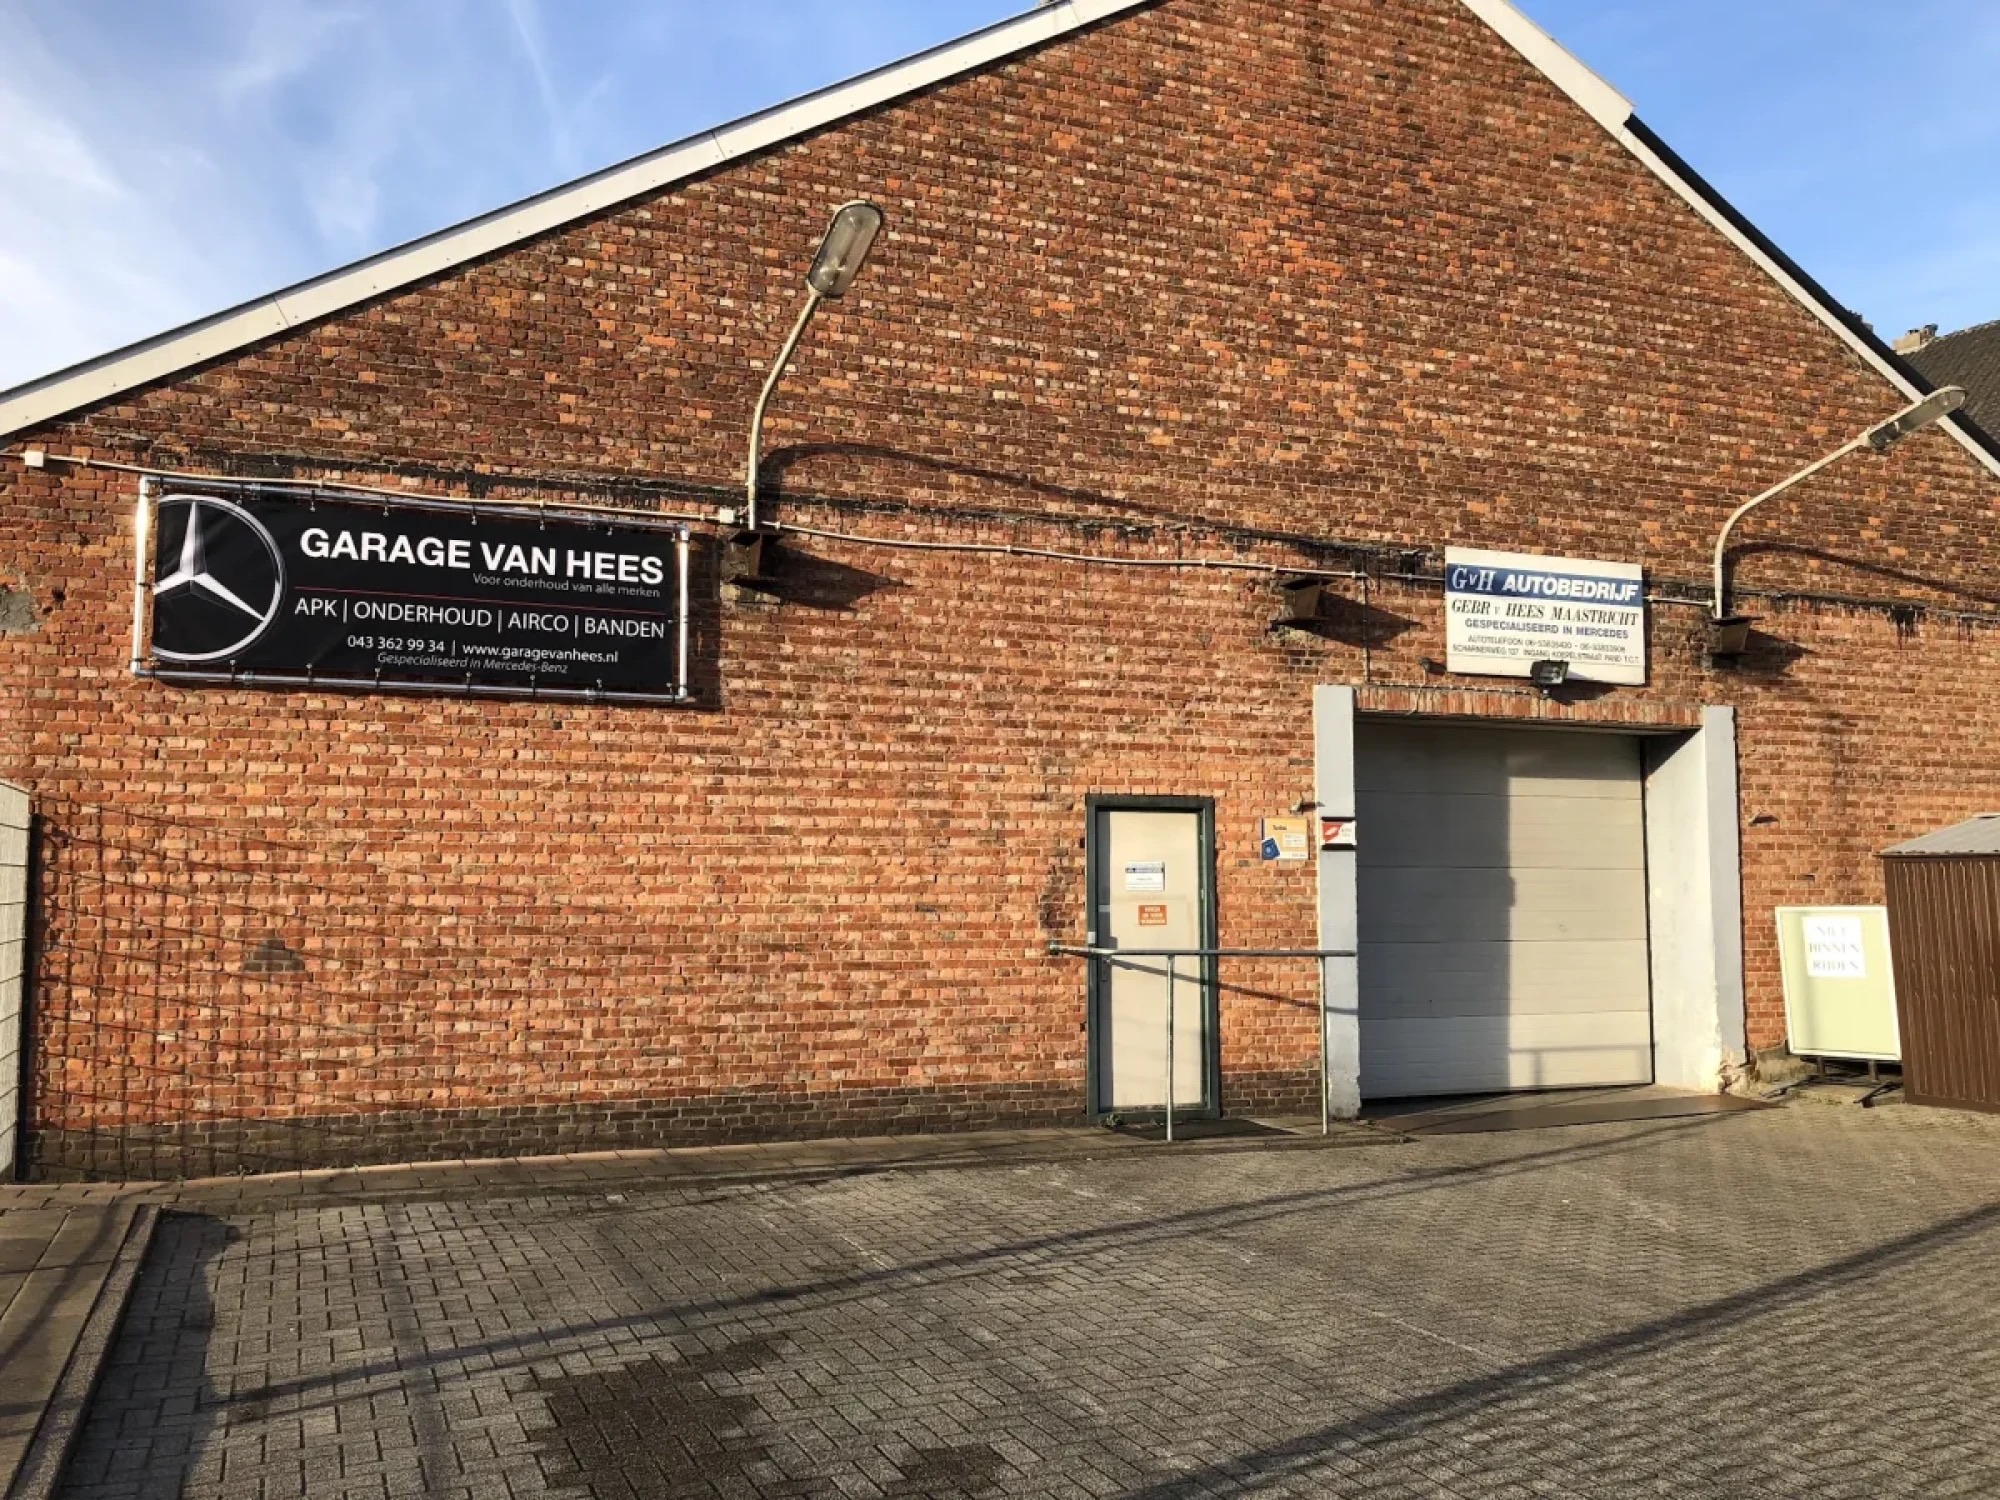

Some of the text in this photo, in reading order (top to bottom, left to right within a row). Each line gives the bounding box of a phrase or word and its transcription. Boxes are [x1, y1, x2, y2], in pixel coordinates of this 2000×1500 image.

[300, 528, 664, 585] GARAGE VAN HEES
[473, 573, 660, 598] Voor onderhoud van alle merken
[1452, 565, 1639, 601] GvH AUTOBEDRIJF
[295, 597, 665, 638] APK ONDERHOUD AIRCO BANDEN
[1451, 599, 1491, 616] GEBR
[1505, 603, 1545, 619] HEES
[1550, 606, 1639, 626] MAASTRICHT
[1465, 618, 1629, 639] GESPECIALISEERD IN MERCEDES
[1468, 635, 1523, 646] AUTOTELEFOON
[347, 635, 619, 663] 043 362 99 34 www.garagevanhees.nl
[378, 652, 568, 674] Gespecialiseerd in Mercedes-Benz
[1809, 943, 1859, 953] BINNEN
